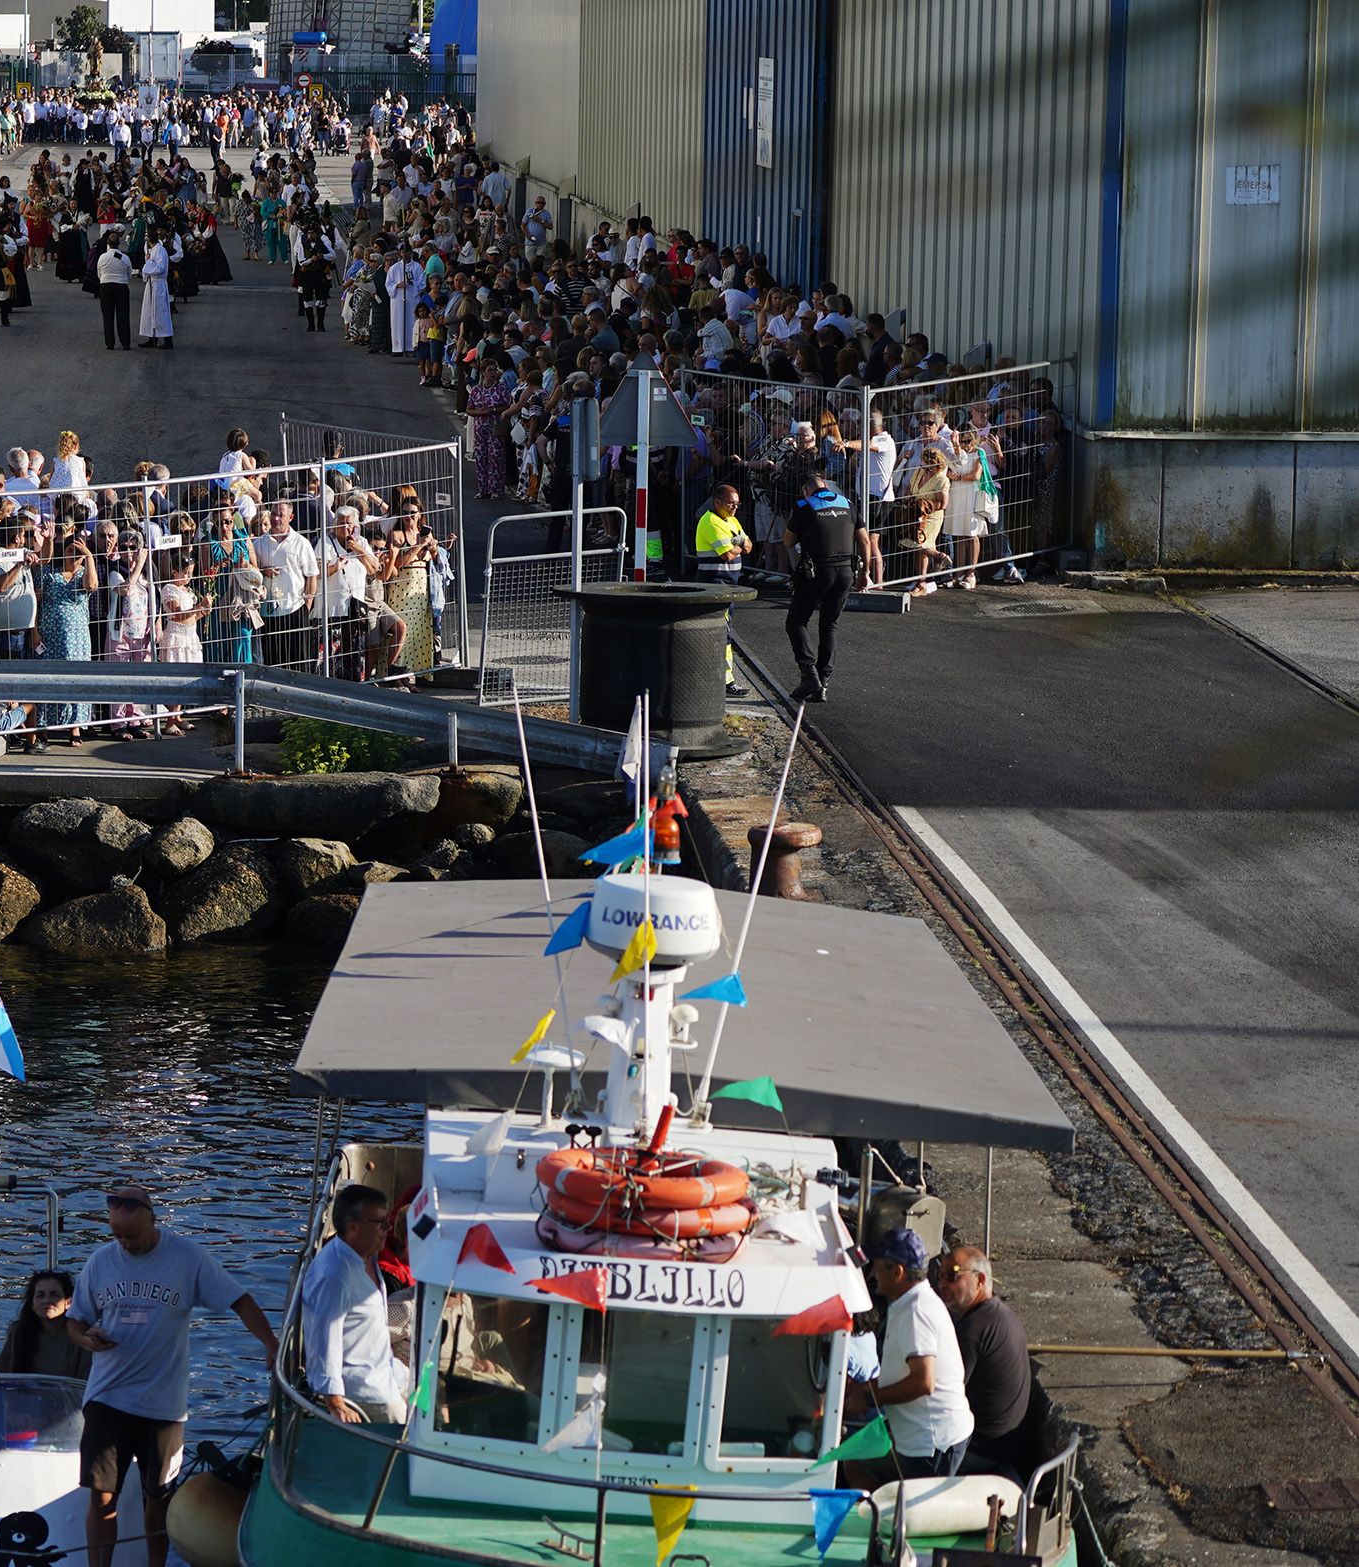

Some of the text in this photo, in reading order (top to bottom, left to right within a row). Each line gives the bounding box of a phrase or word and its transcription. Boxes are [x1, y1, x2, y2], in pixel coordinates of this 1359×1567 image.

[601, 905, 711, 931] LOWRANCE
[96, 1281, 181, 1308] SAN DIEGO
